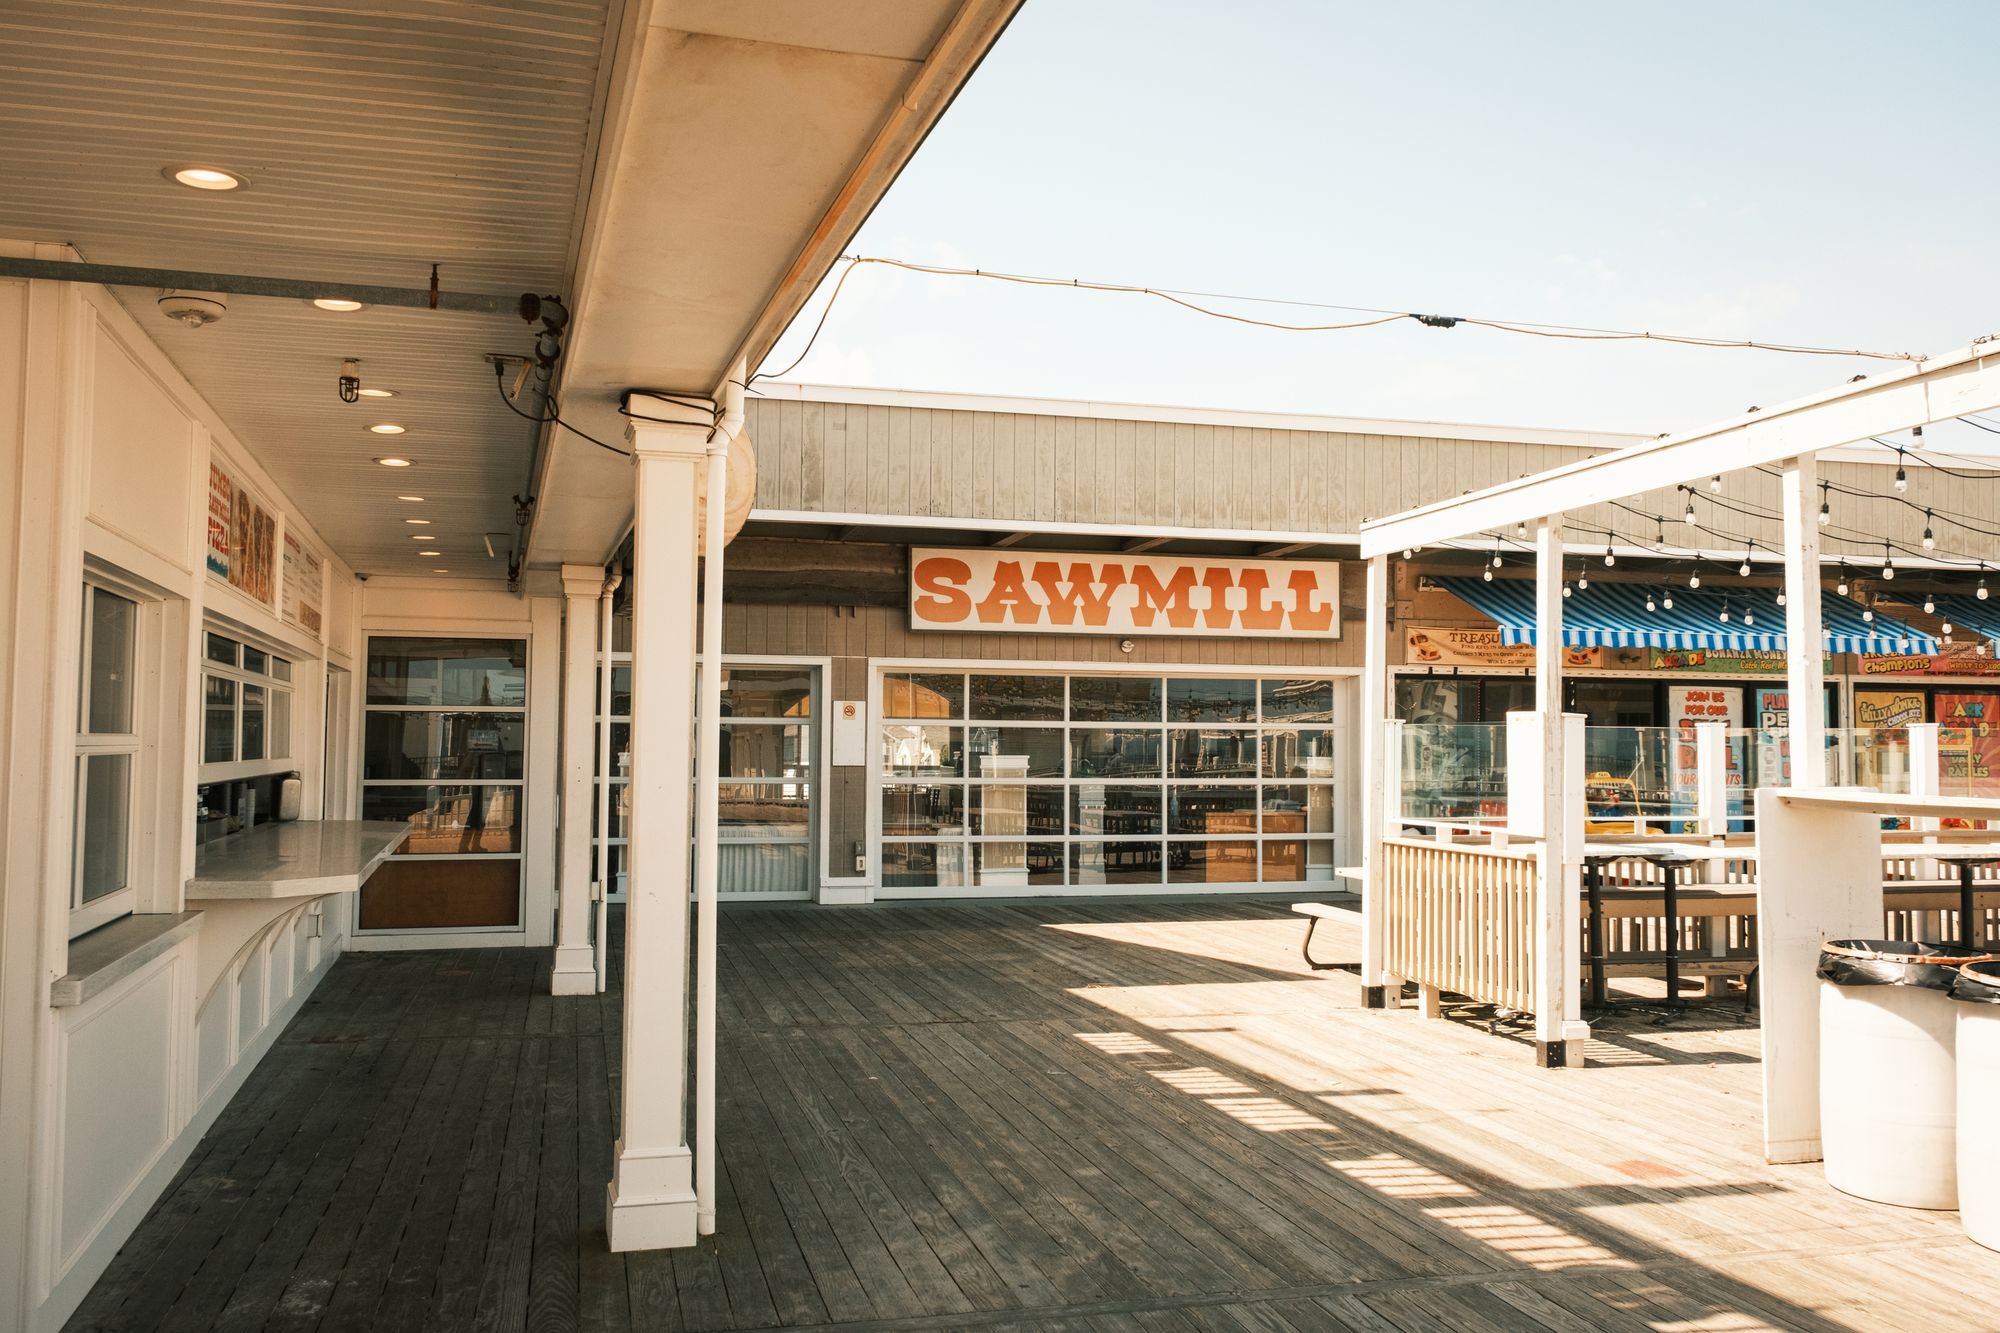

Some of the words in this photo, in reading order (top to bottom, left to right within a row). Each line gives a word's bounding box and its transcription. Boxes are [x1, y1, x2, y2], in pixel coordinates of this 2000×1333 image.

[913, 557, 1334, 630] SAWMILL
[1450, 633, 1500, 644] TREASU
[1654, 652, 1706, 669] ARCADE
[1685, 691, 1709, 702] JOIN
[1711, 691, 1725, 703] US
[1685, 704, 1706, 715] FOR
[1707, 705, 1728, 716] OUR
[1860, 701, 1889, 722] WILLY
[1945, 702, 1984, 718] PARK
[1677, 745, 1738, 770] BL
